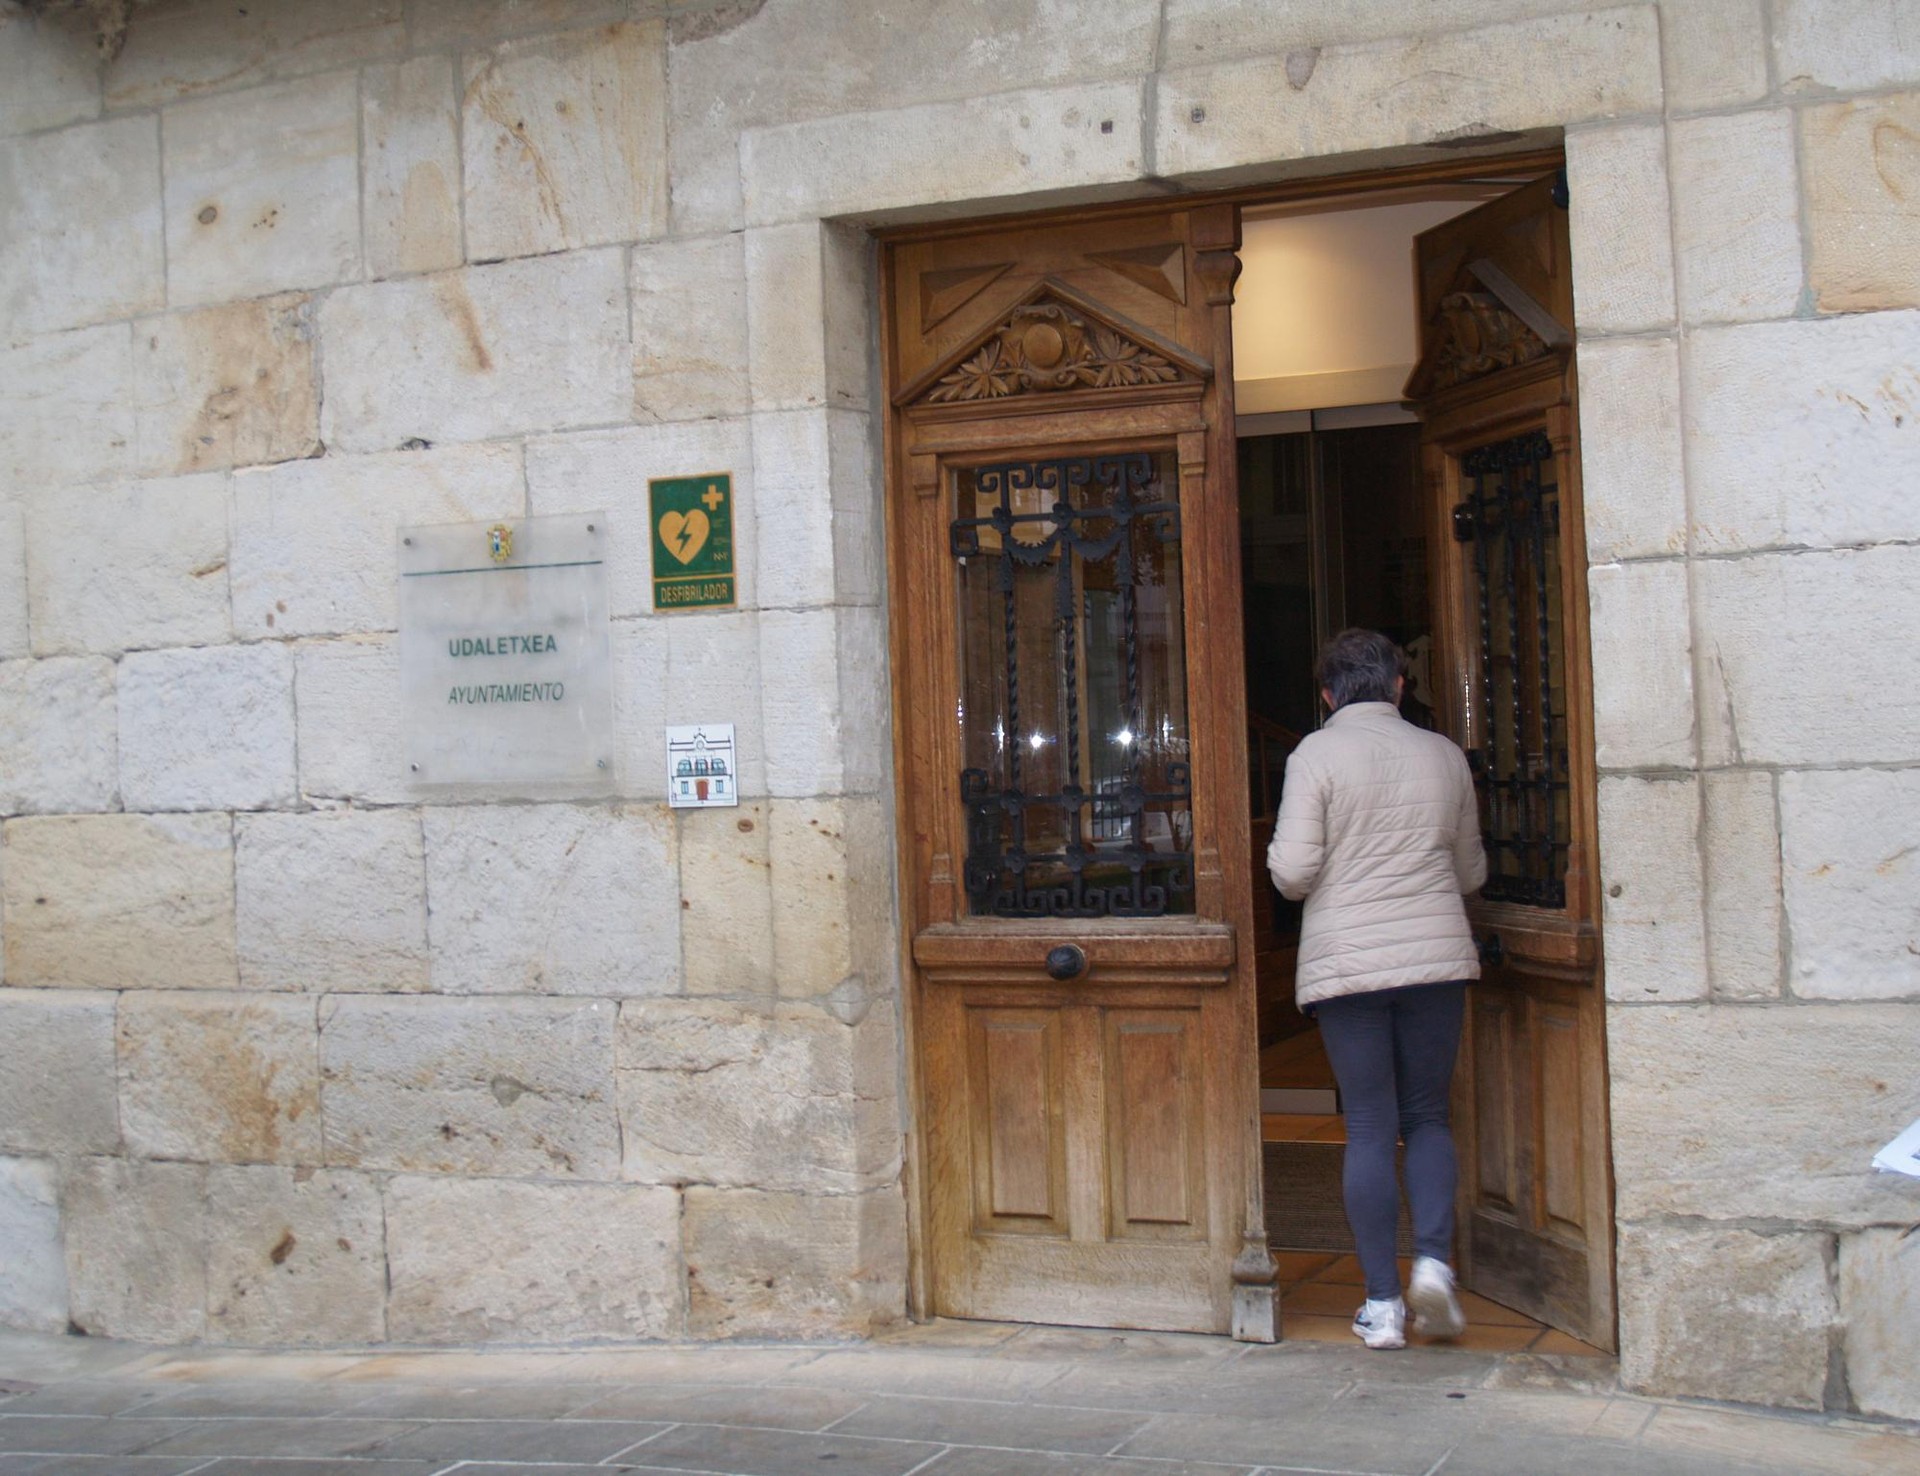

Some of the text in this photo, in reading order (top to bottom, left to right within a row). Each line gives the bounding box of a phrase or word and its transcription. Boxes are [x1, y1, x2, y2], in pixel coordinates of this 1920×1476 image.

[661, 583, 728, 603] DESFIBRILADOR
[448, 634, 558, 657] UDALETXEA
[448, 682, 564, 705] AYUNTAMIENTO
